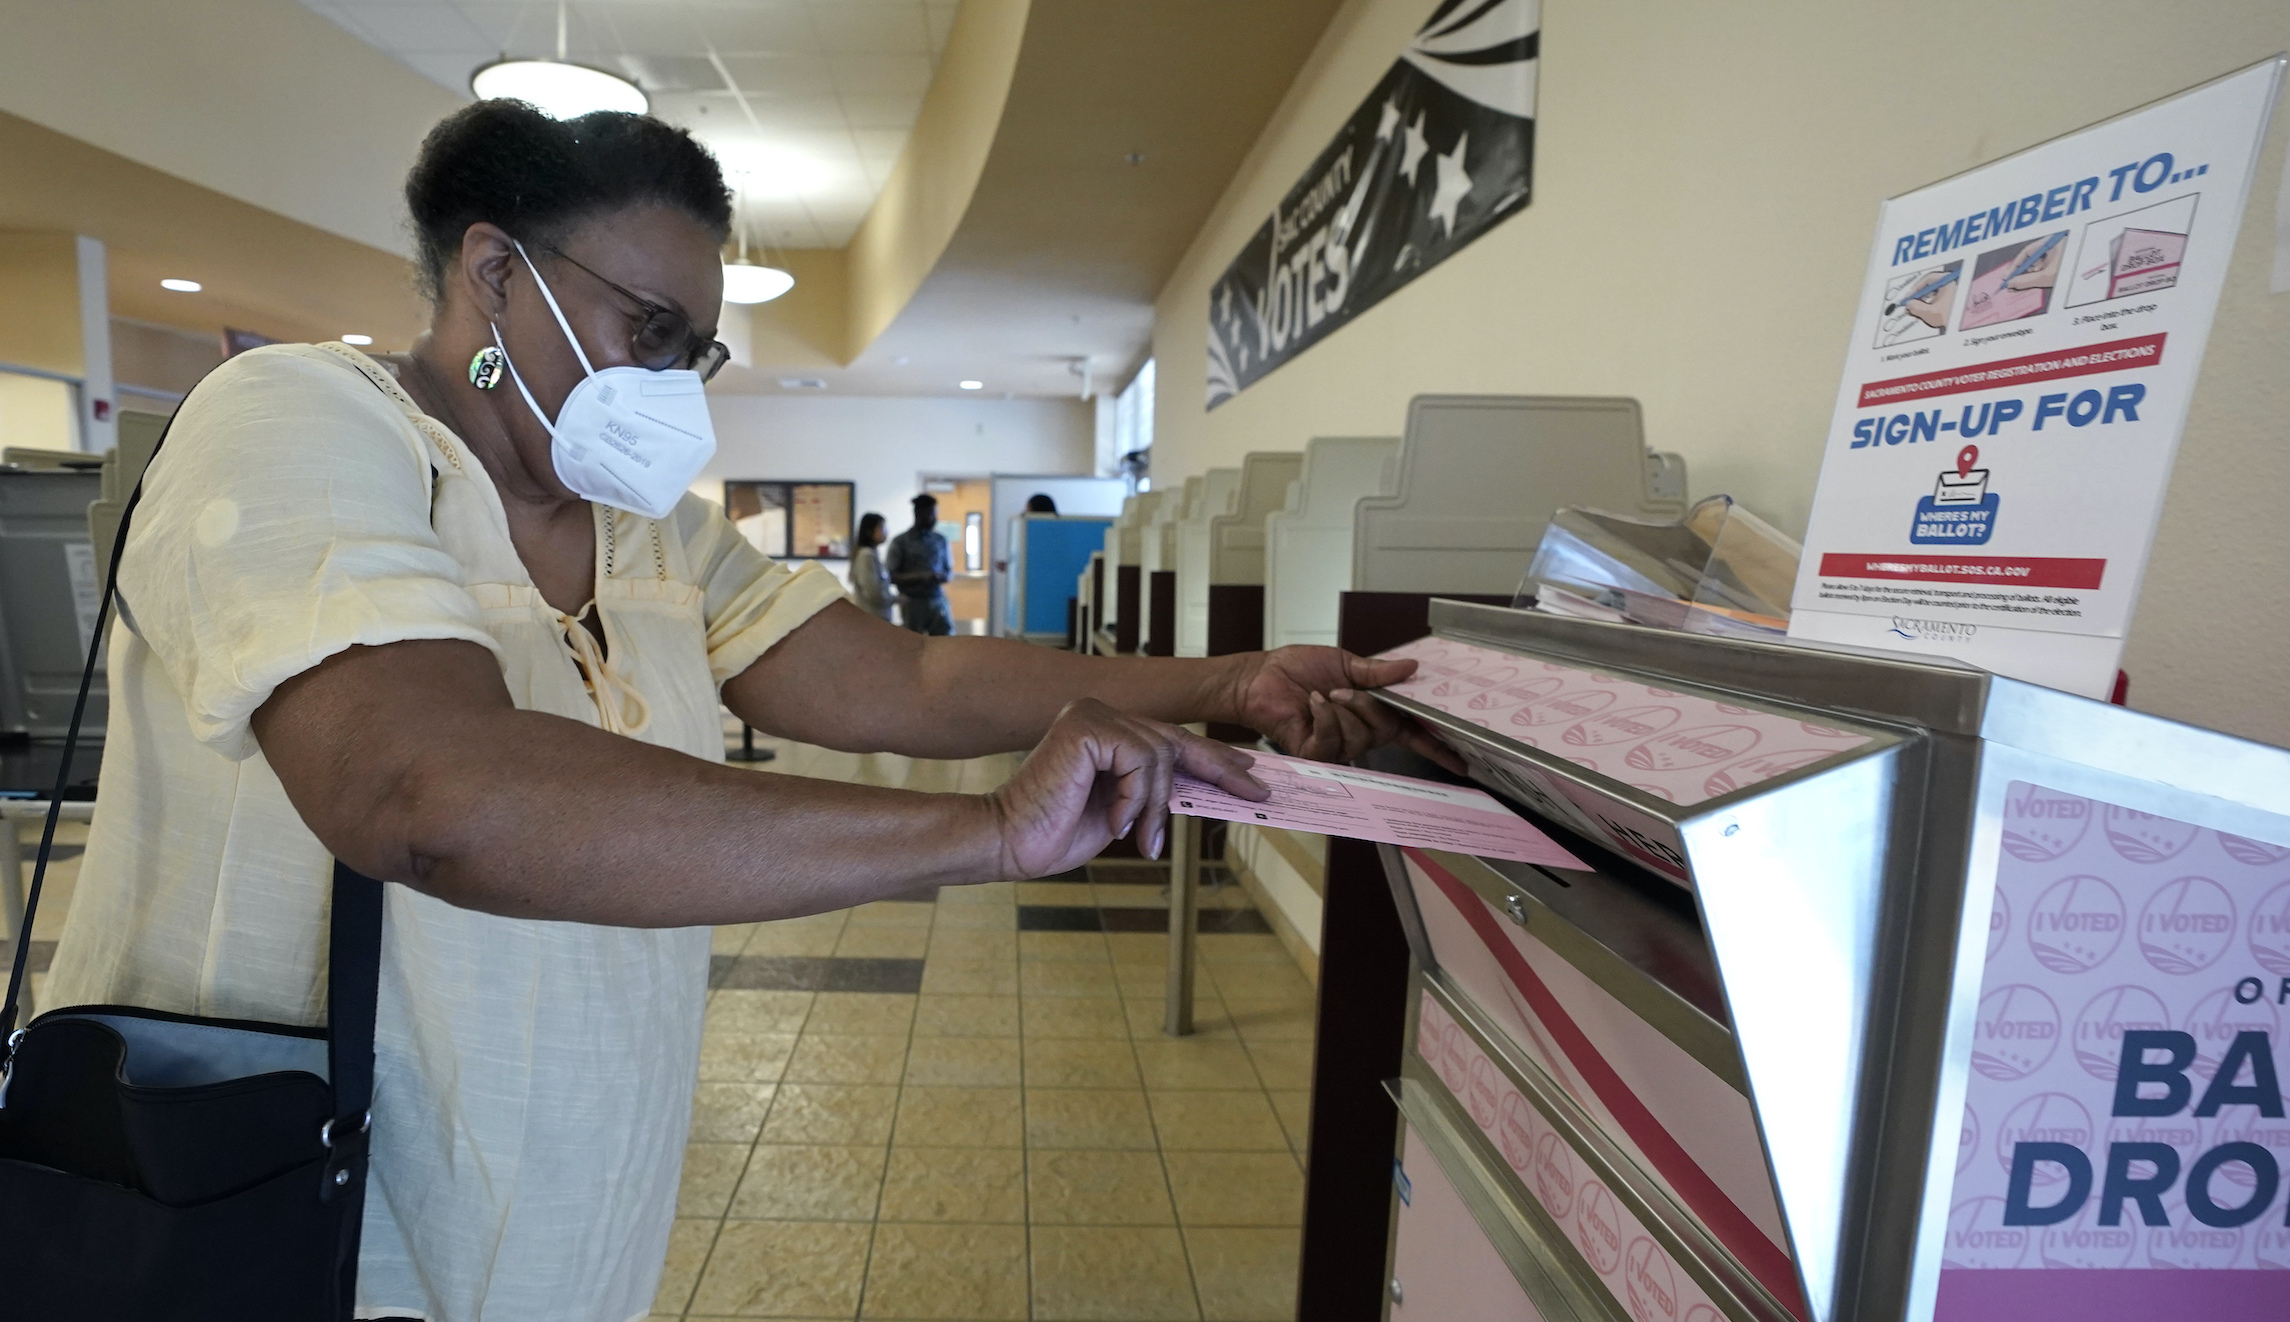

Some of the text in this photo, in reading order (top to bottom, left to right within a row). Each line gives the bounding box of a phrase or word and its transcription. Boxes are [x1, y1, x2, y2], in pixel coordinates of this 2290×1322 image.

[1891, 152, 2209, 267] REMEMBER TO...
[1256, 205, 1350, 361] VOTES
[1864, 343, 2157, 399] SACRAMENTO COUNTY VOTER REGISTRATION AND ELECTIONS
[1850, 383, 2147, 450] SIGN-UP FOR
[605, 420, 639, 446] KN95
[1969, 510, 1991, 521] MY
[1915, 523, 1987, 538] BALLOT?
[1892, 615, 1977, 636] SACRAMENTO
[1924, 632, 1971, 644] COUNTY
[1668, 736, 1733, 760] VOTED
[2015, 798, 2086, 820] VOTED
[2035, 912, 2121, 933] I VOTED
[2145, 913, 2232, 934] I VOTED
[1984, 1021, 2057, 1040] VOTED
[2111, 1030, 2286, 1118] BA
[2018, 1128, 2088, 1146] VOTED
[2126, 1128, 2195, 1147] VOTED
[1543, 1154, 1571, 1197] VOTED
[2003, 1141, 2290, 1229] DRO
[1586, 1204, 1619, 1252] VOTED
[1955, 1230, 2024, 1249] VOTED
[2050, 1230, 2131, 1249] I VOTED
[2156, 1230, 2239, 1250] I VOTED
[1636, 1261, 1675, 1318] VOTED
